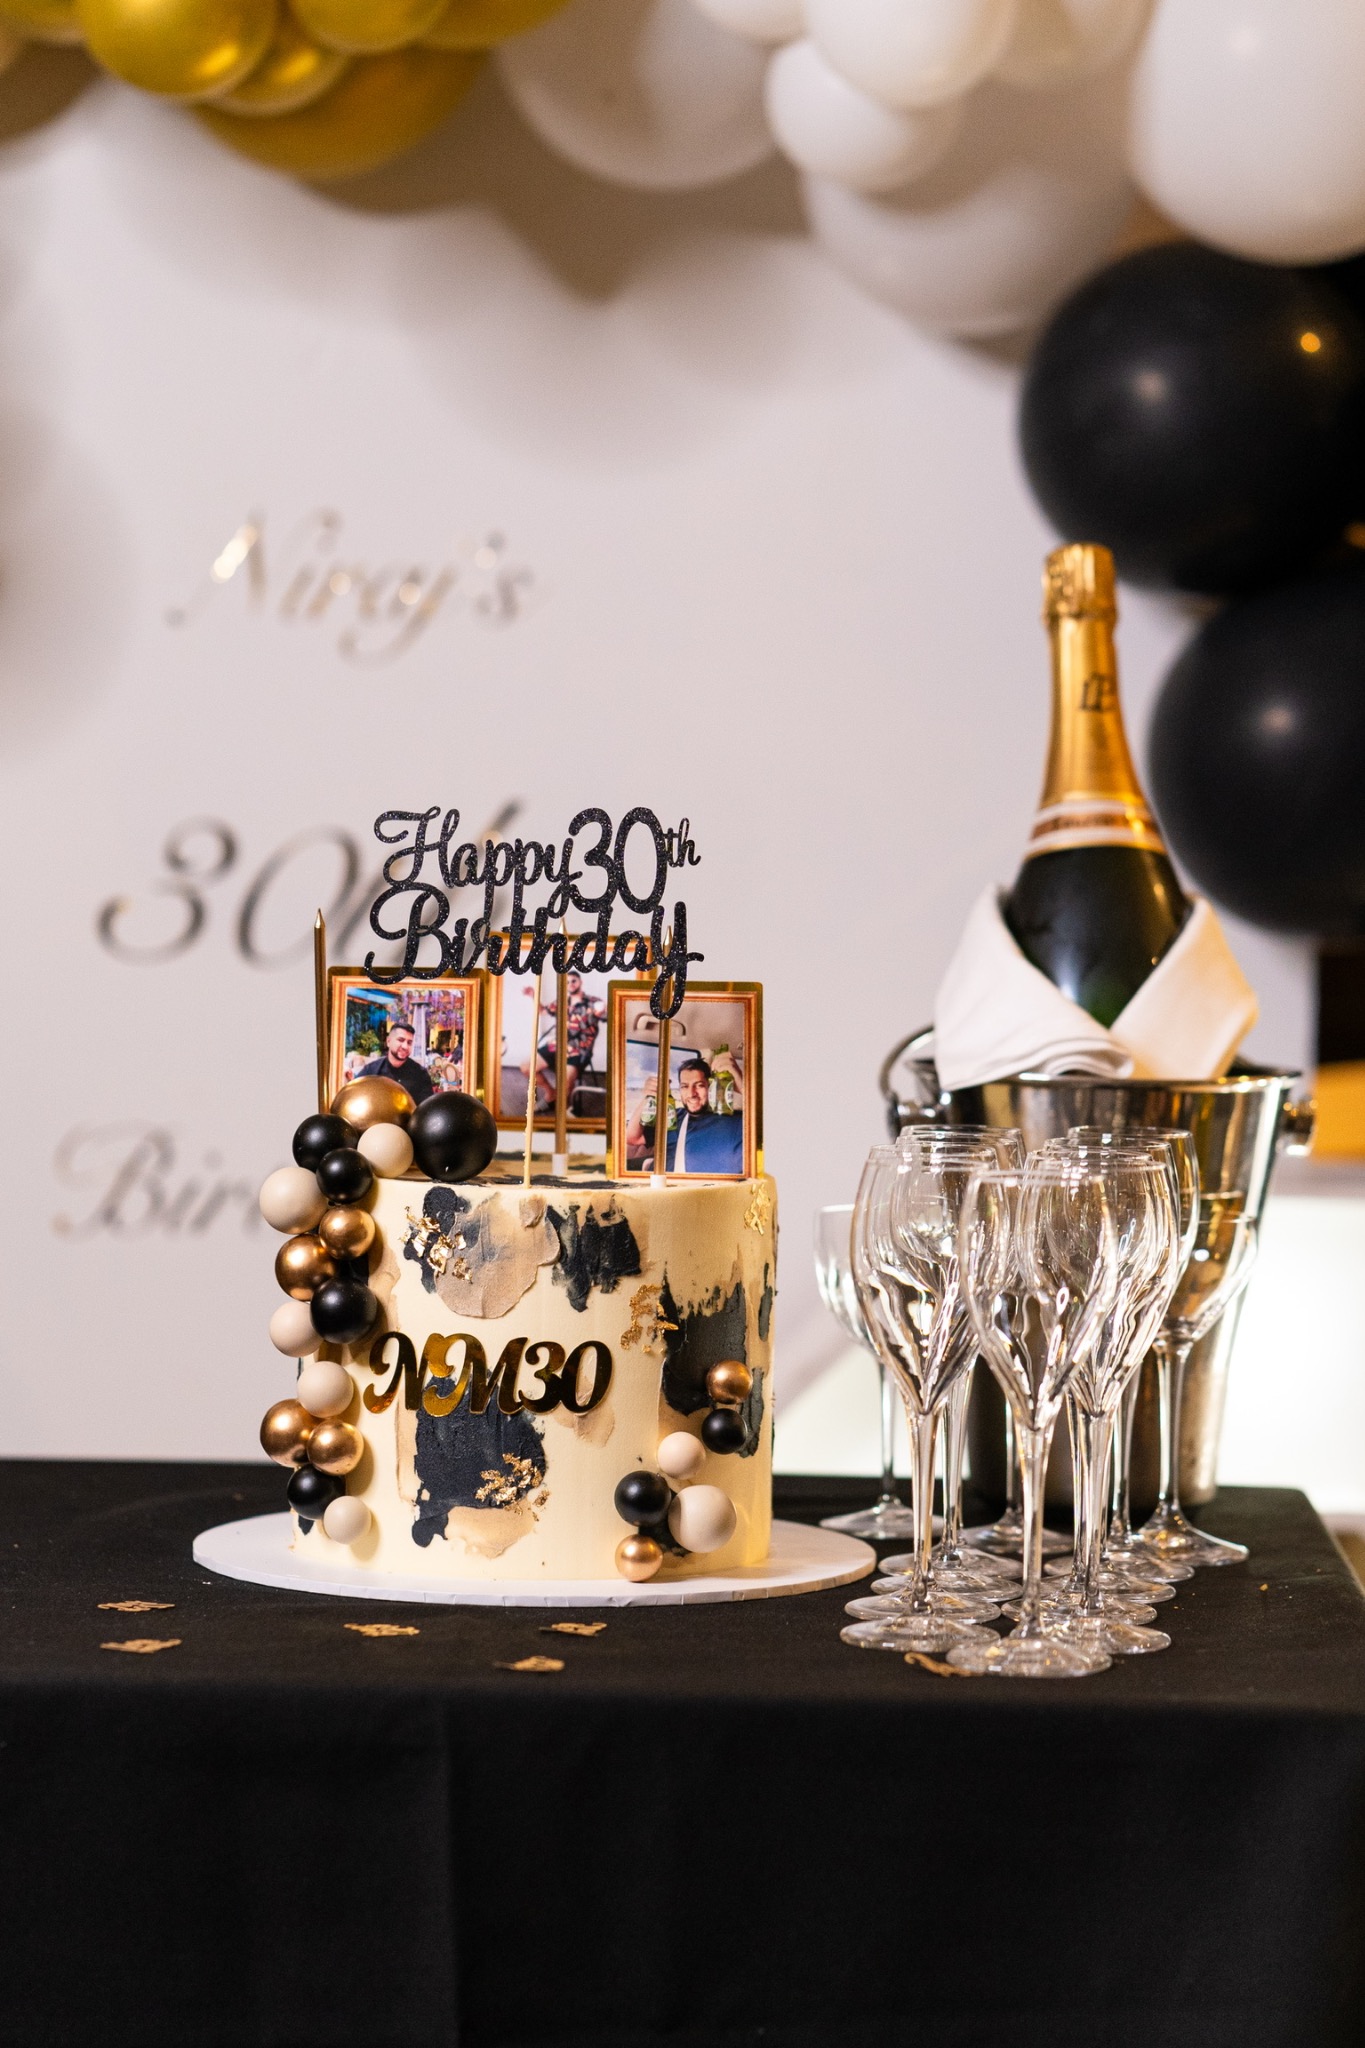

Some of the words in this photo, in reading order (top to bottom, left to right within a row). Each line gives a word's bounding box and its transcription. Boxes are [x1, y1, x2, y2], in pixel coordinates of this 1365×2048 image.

[373, 805, 583, 919] Happy
[567, 806, 701, 914] 30th
[364, 882, 704, 1020] Birthday
[363, 1331, 613, 1417] NM30
